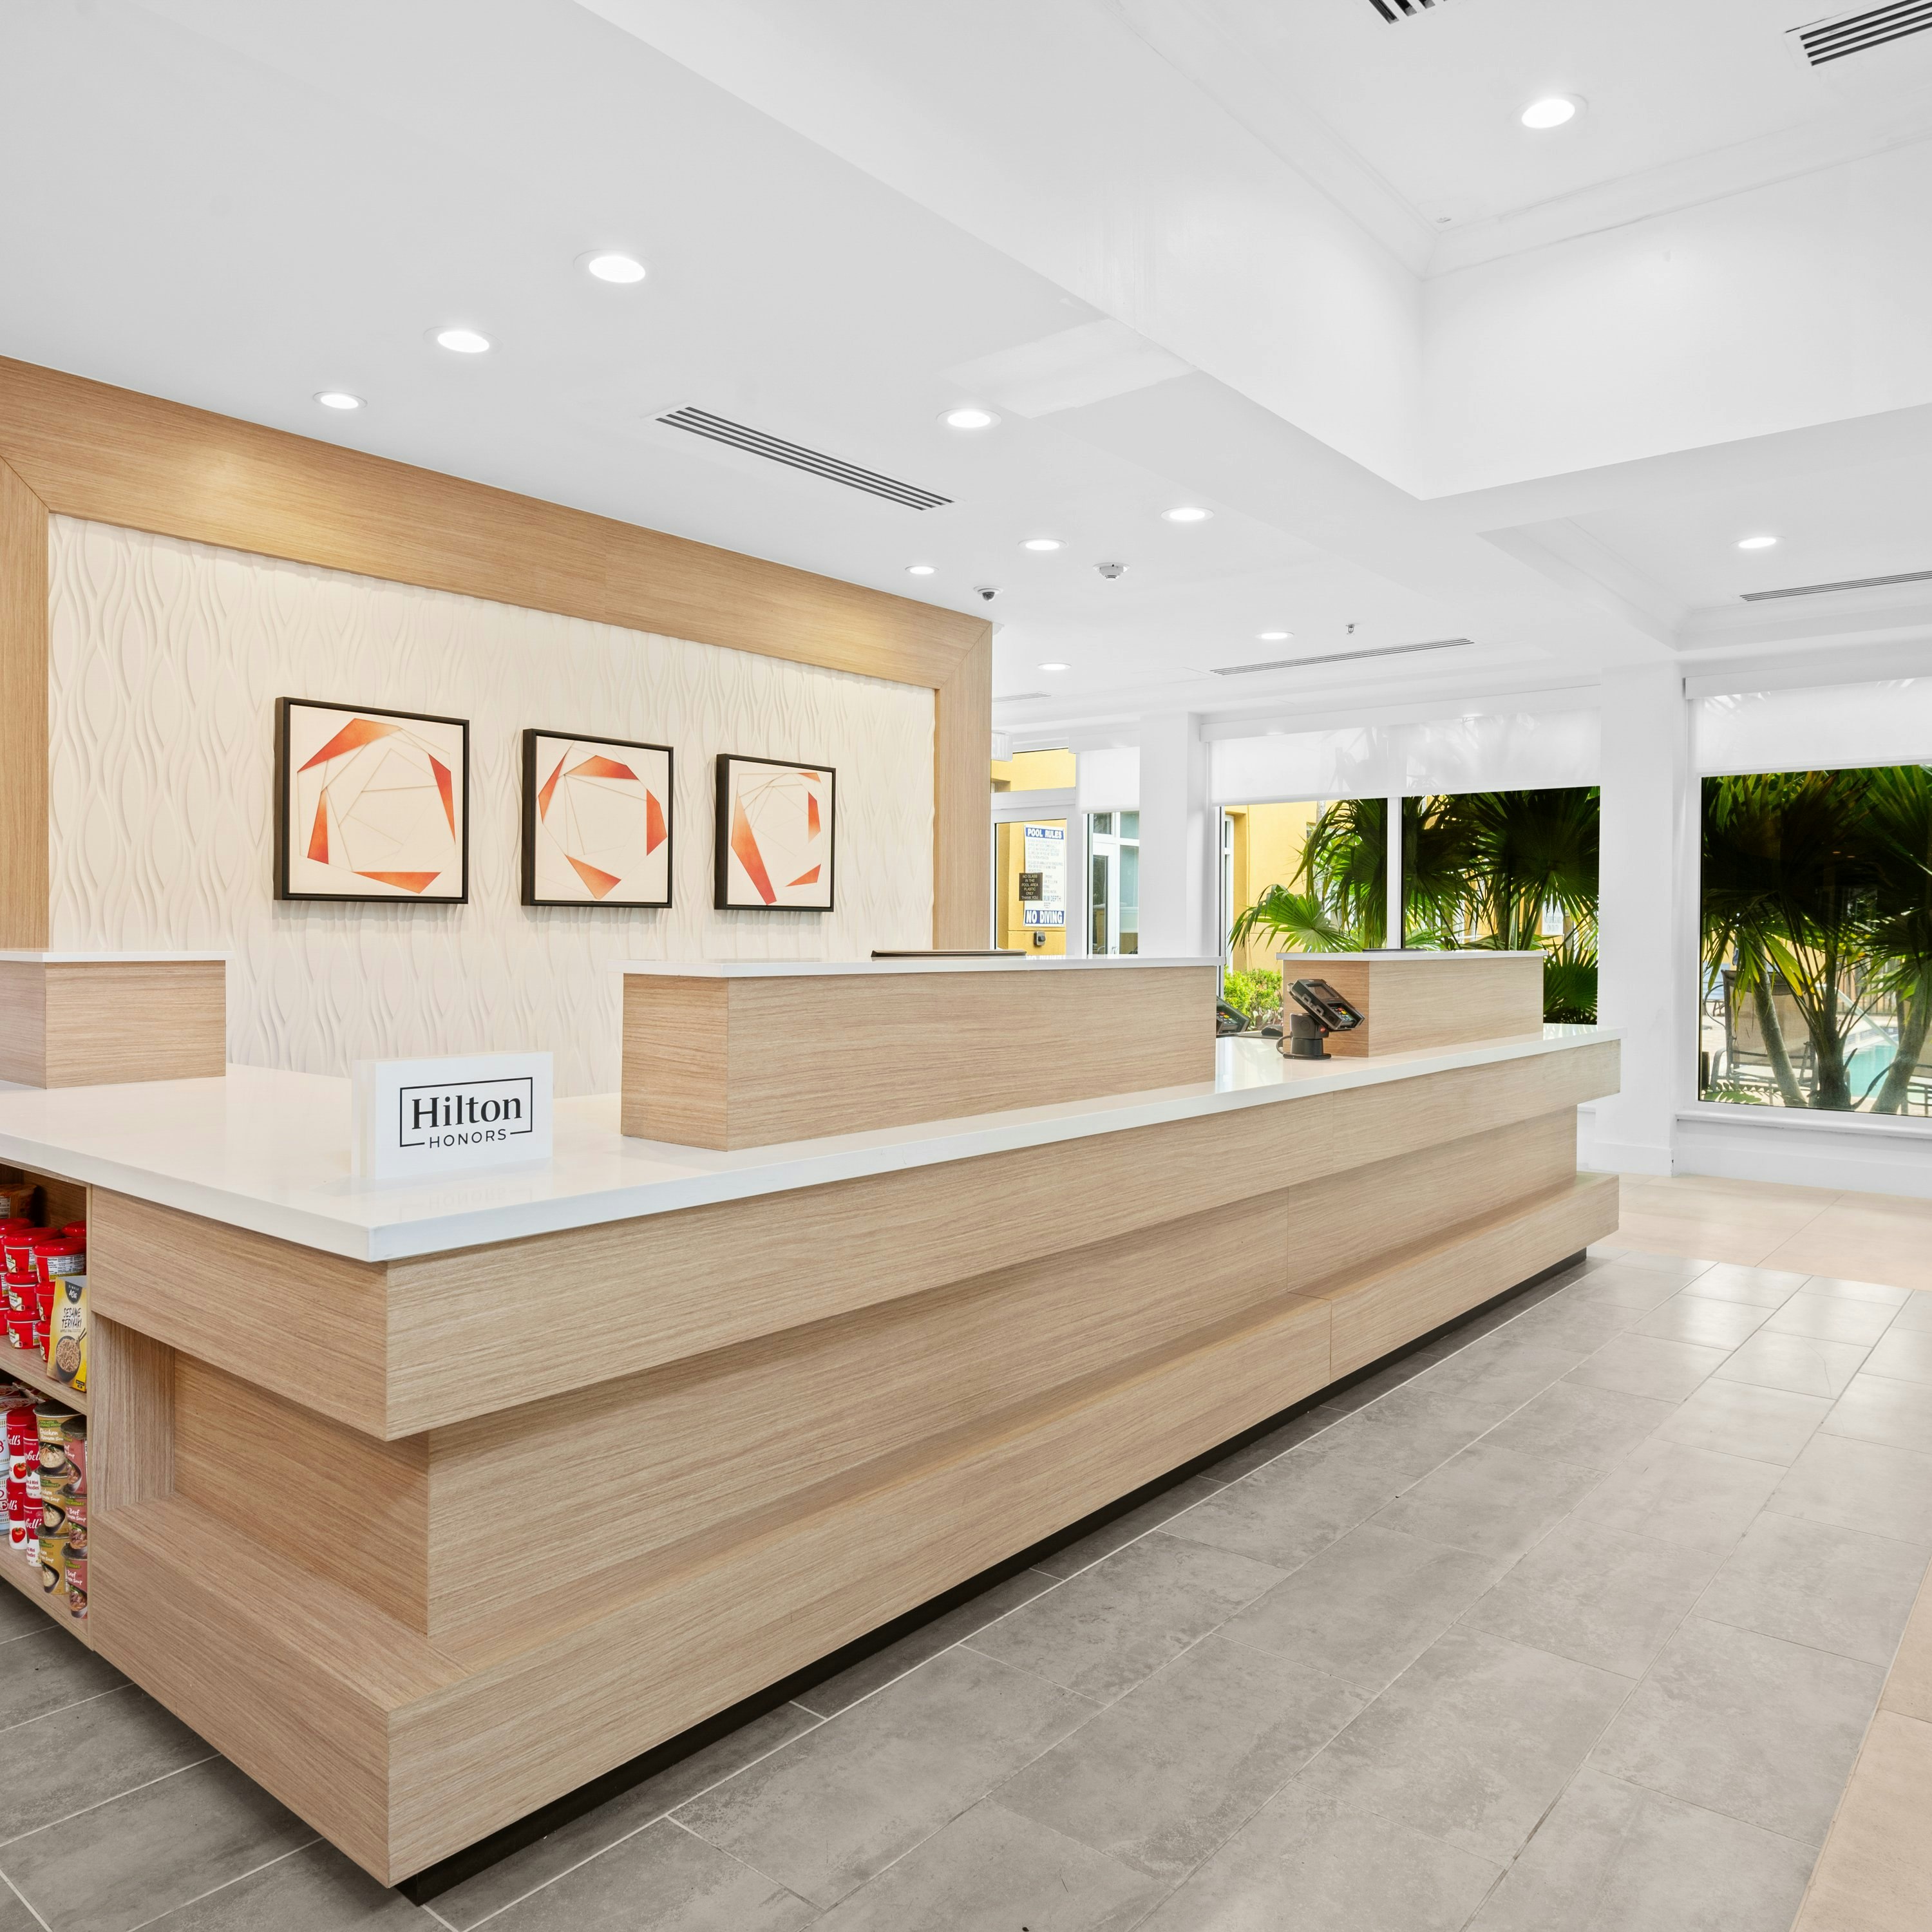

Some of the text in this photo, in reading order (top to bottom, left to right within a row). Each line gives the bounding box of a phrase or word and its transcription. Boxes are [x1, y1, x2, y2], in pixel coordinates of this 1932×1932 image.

[1027, 828, 1062, 839] POOL RULES
[1027, 911, 1063, 923] NO DIVING
[412, 1094, 522, 1130] Hilton
[430, 1128, 506, 1148] HONORS
[63, 1307, 81, 1318] SESAME
[62, 1318, 82, 1329] TERIYAKI
